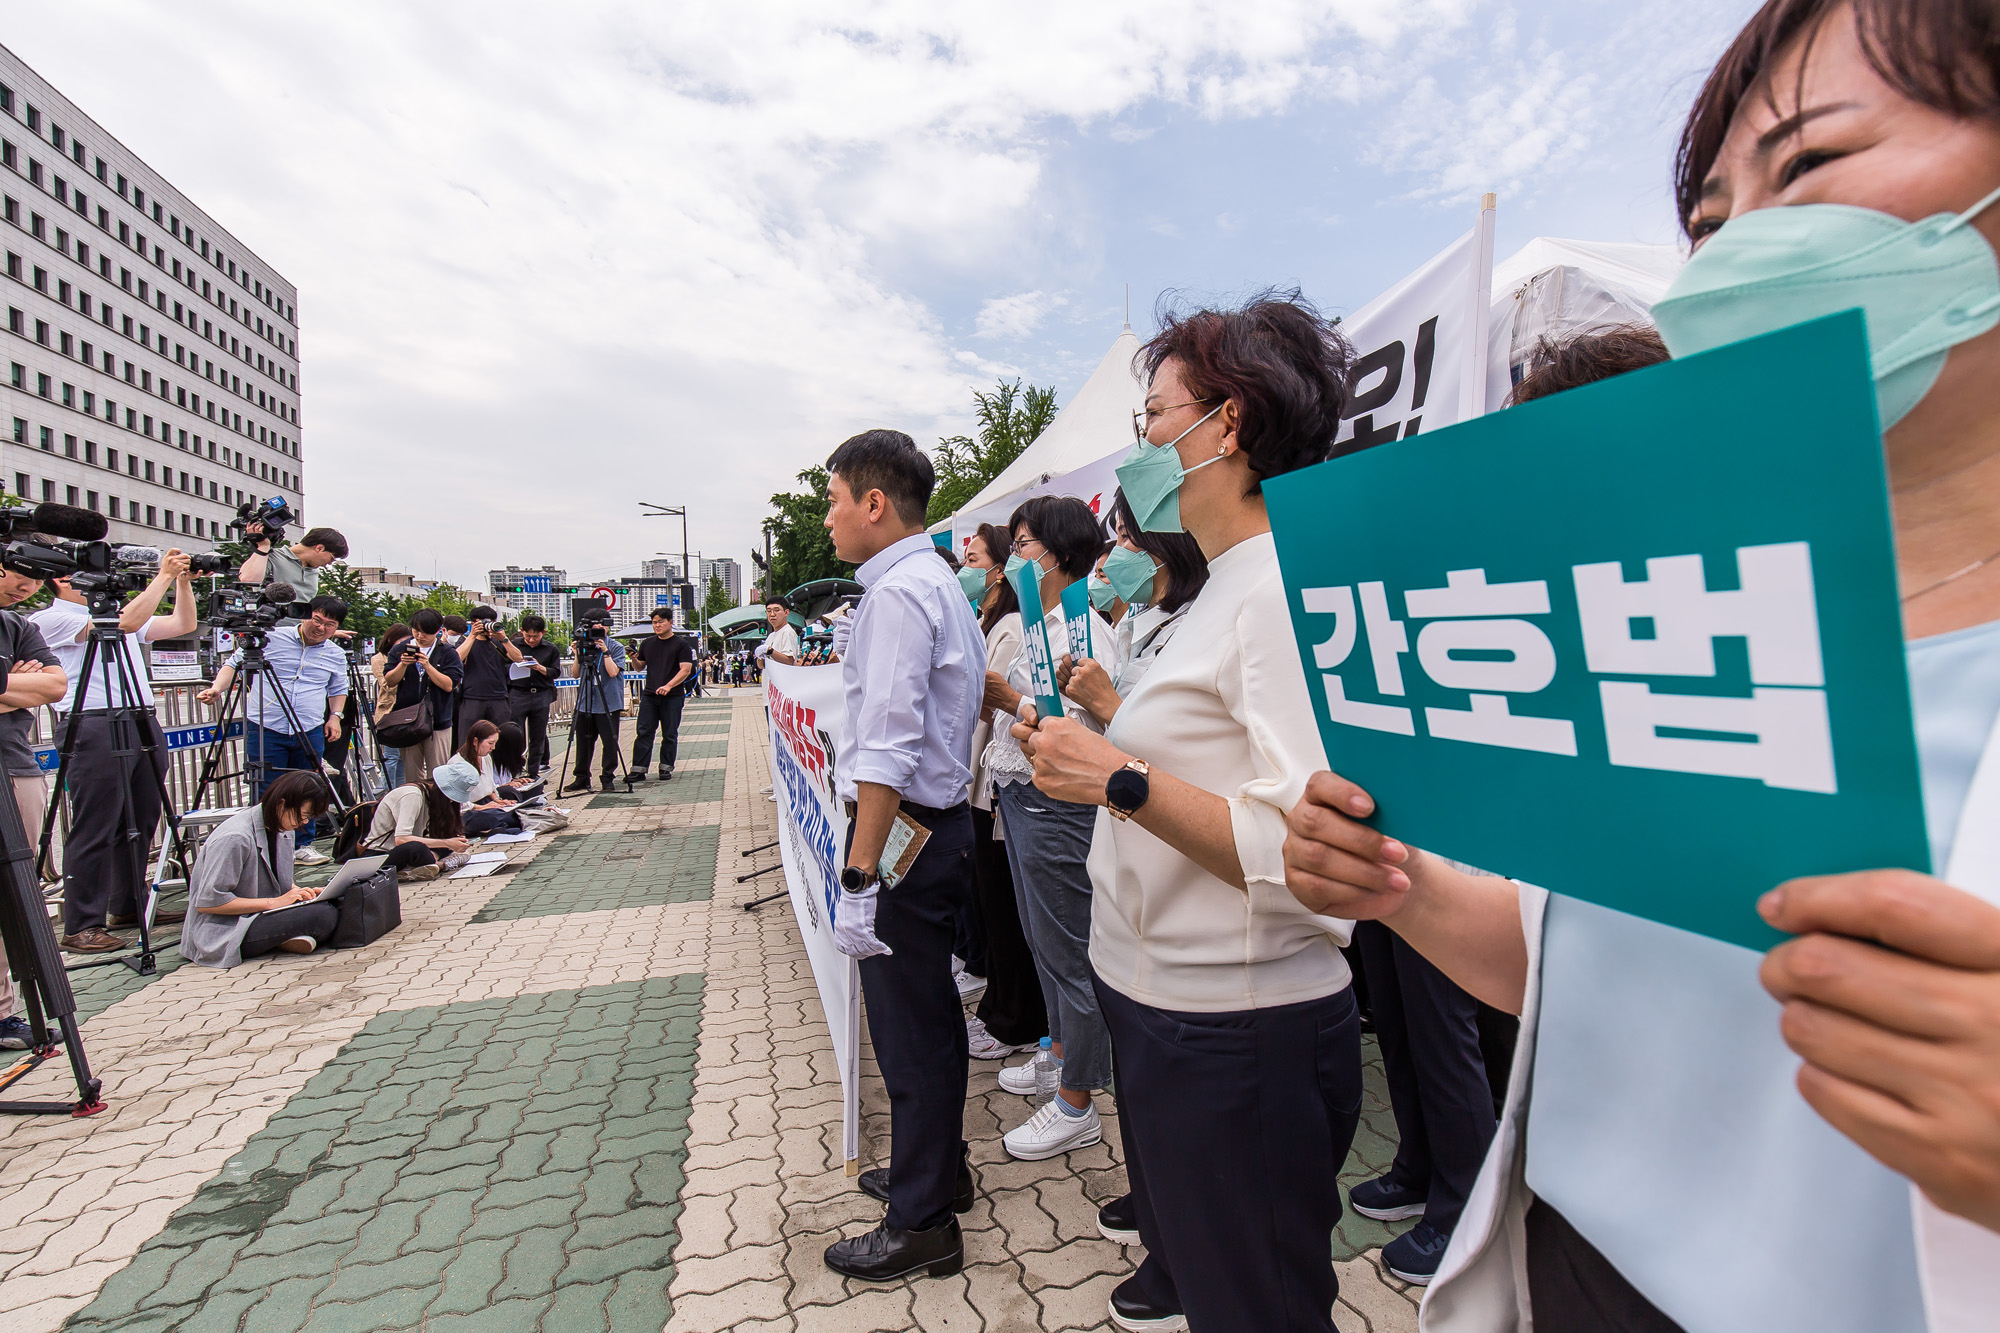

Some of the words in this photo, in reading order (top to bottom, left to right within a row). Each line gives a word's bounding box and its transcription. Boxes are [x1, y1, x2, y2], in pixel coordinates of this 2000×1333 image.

[1067, 613, 1088, 662] 호법
[1300, 540, 1839, 796] 간호법
[166, 729, 205, 747] LINE
